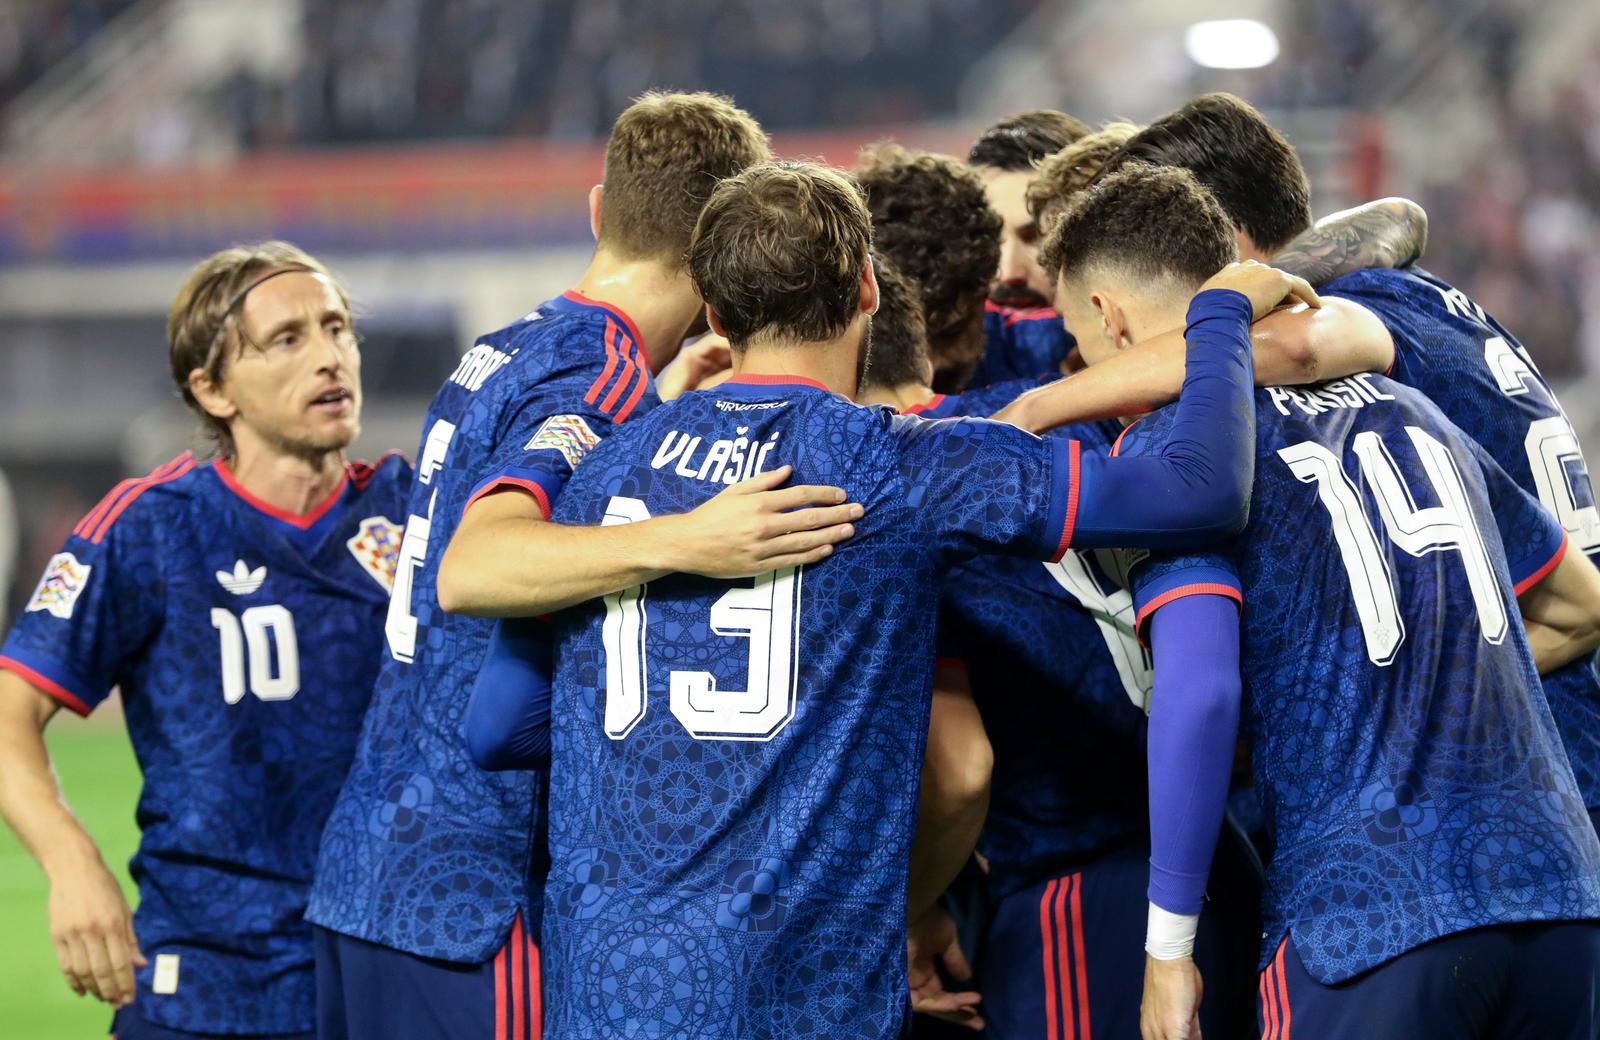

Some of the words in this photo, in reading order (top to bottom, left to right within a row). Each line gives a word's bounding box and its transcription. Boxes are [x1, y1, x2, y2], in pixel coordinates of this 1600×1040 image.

[650, 426, 780, 485] VLAŠIĆ
[601, 495, 804, 742] 13
[1276, 425, 1508, 667] 14
[210, 604, 300, 705] 10
